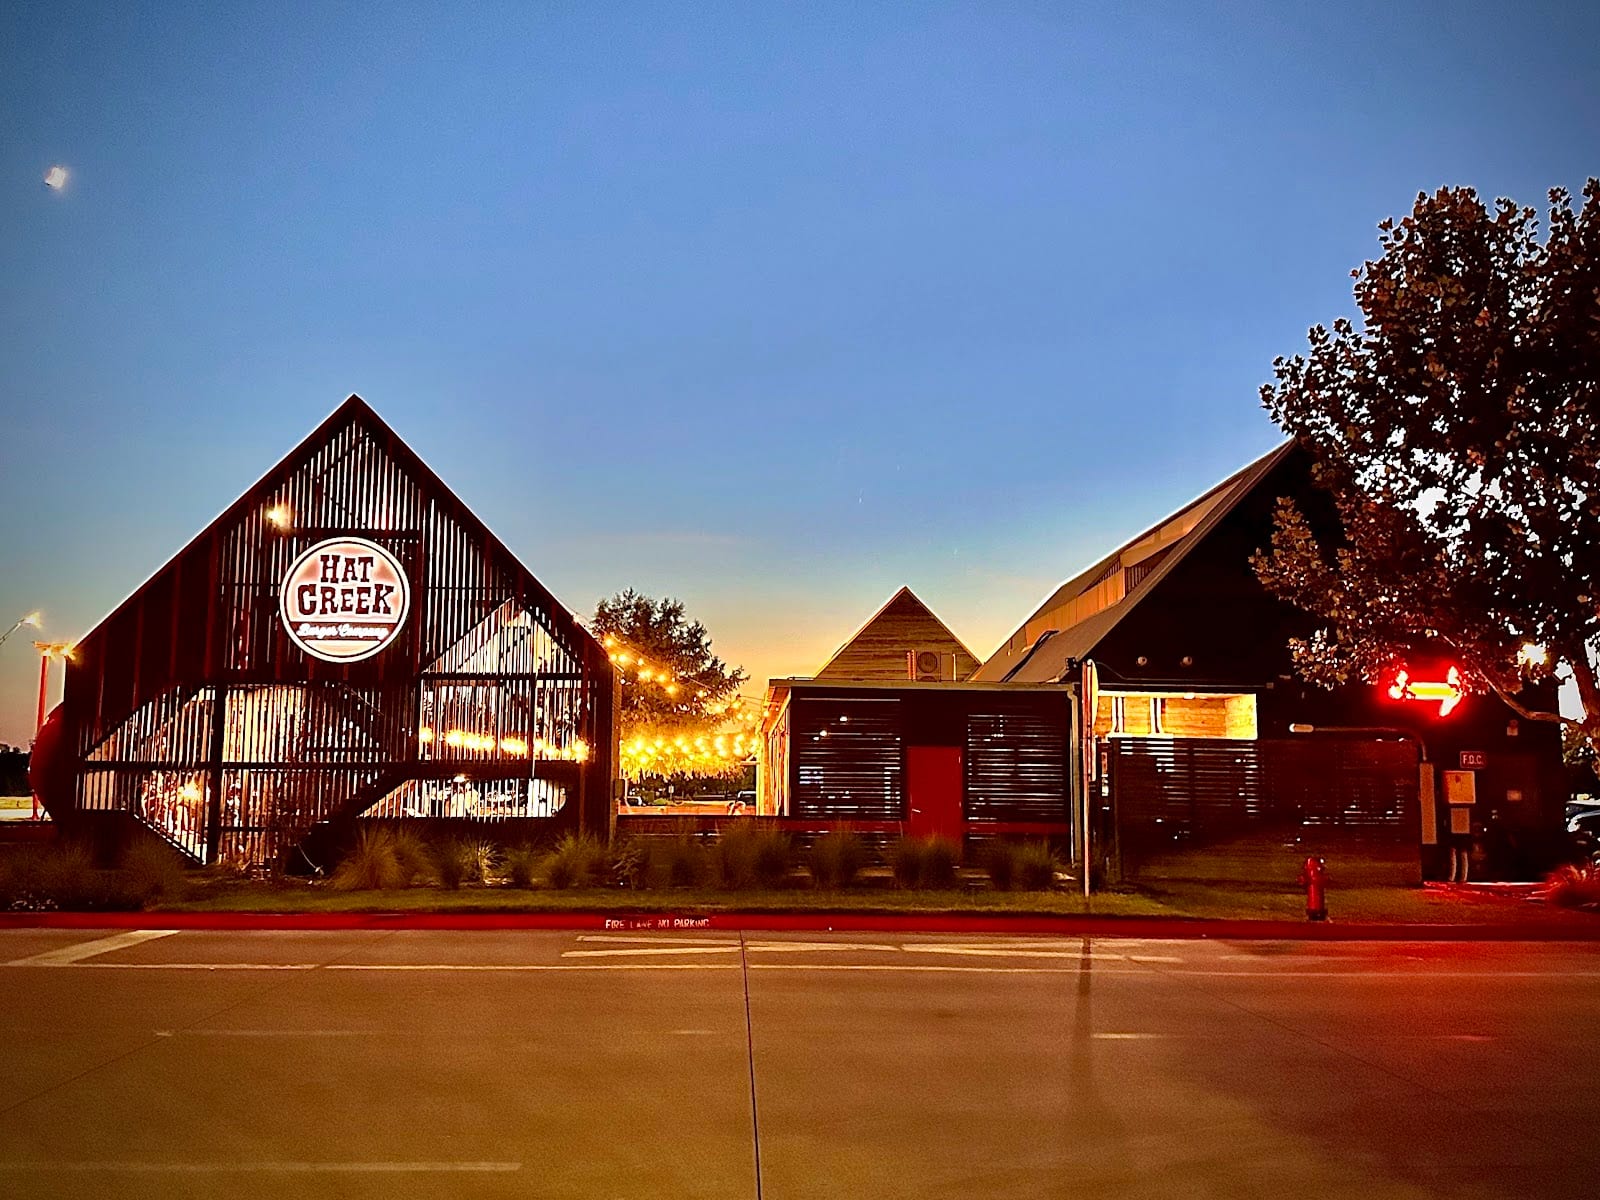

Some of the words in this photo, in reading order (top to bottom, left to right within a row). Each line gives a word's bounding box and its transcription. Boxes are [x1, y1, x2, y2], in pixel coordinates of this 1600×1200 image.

[320, 555, 374, 584] HAT
[297, 583, 395, 616] CREEK
[605, 919, 625, 929] FIRE
[673, 918, 710, 929] PARKING
